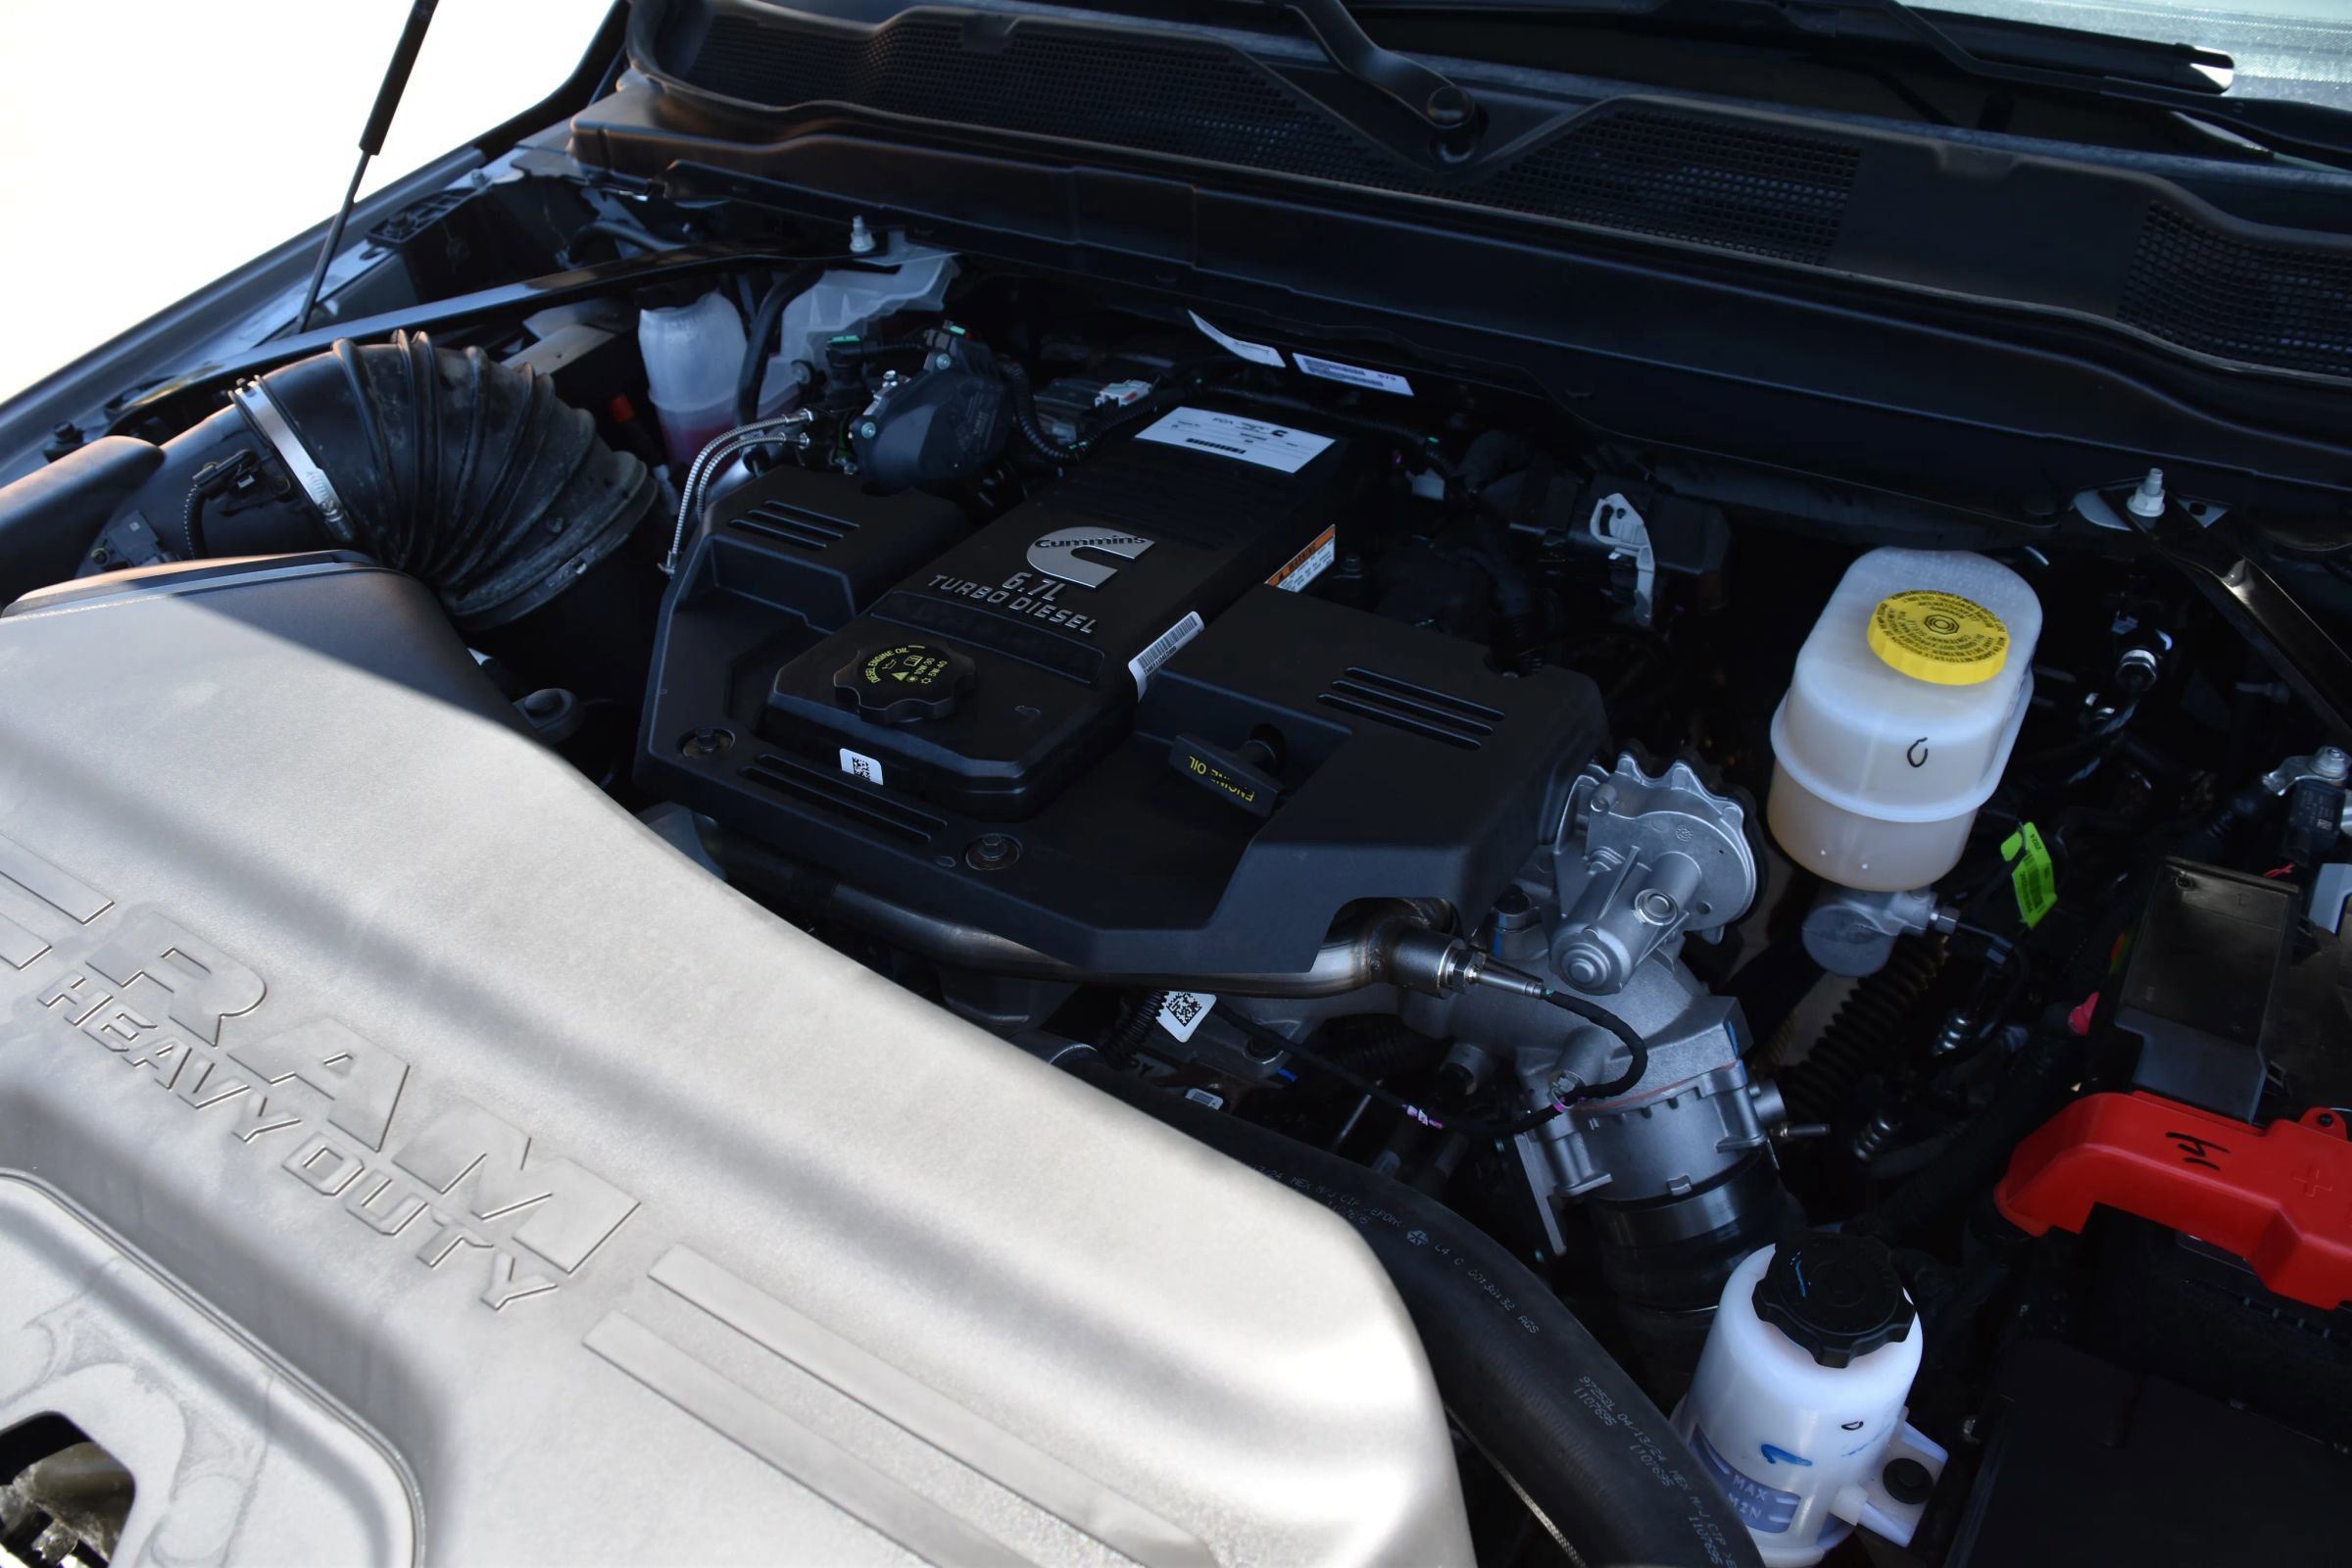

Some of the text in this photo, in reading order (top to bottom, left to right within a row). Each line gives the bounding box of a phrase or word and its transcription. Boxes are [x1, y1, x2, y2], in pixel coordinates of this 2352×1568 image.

[1034, 534, 1147, 549] Cummins
[1001, 572, 1067, 603] 6.7L
[927, 574, 1099, 635] TURBO DIESEL
[867, 650, 895, 668] ENGINE
[1189, 755, 1207, 775] OIL
[84, 907, 641, 1276] RAM
[36, 971, 560, 1311] HEAVY DUTY
[1517, 1314, 1541, 1335] AGS
[1733, 1473, 1769, 1502] MAX
[1727, 1492, 1763, 1521] MIN
